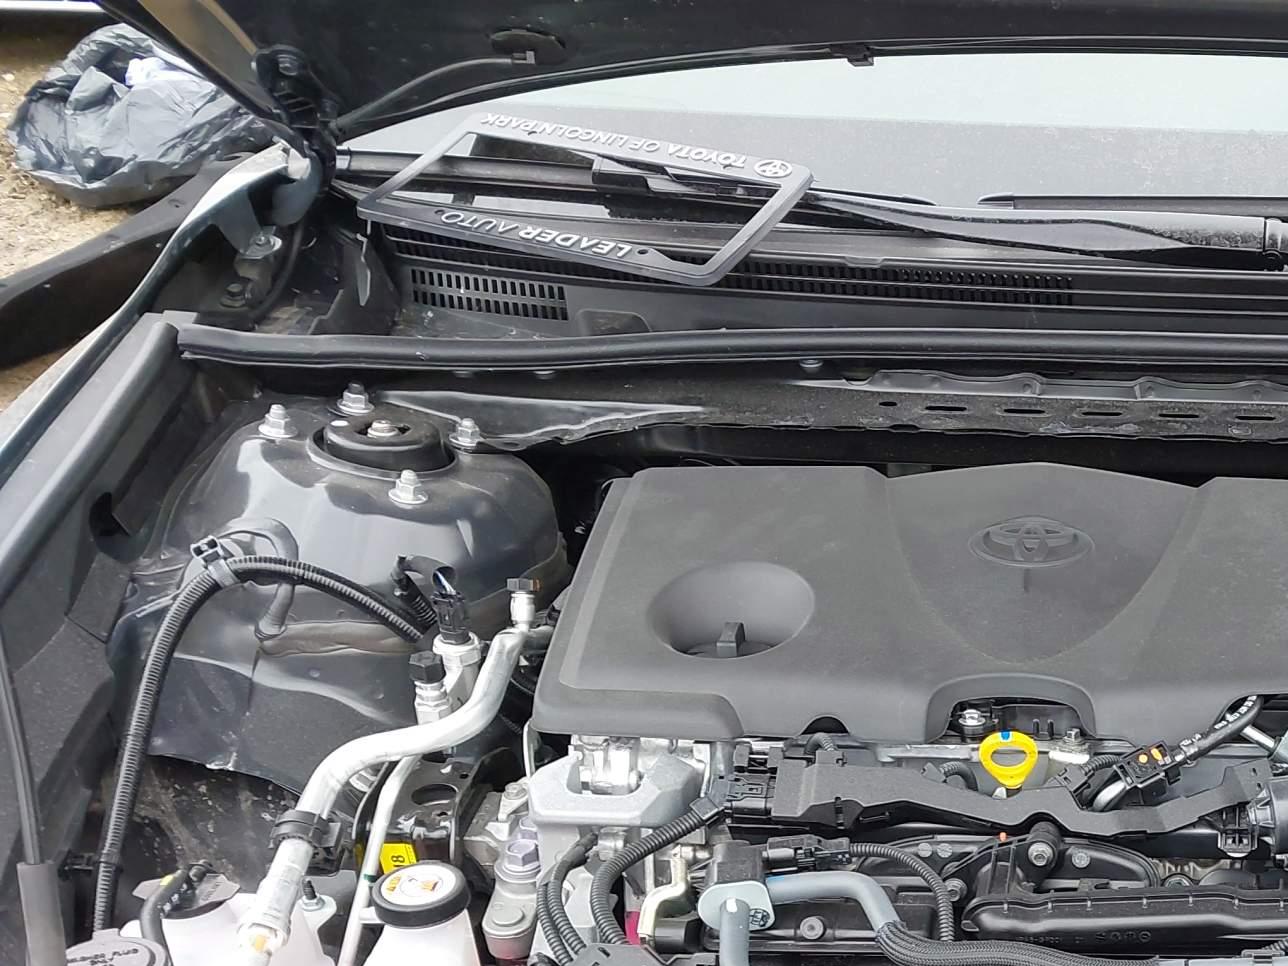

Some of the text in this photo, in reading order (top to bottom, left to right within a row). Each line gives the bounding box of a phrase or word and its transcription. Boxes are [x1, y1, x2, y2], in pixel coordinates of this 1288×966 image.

[480, 112, 750, 169] TOYOTA OF LINCOLN PARK
[440, 210, 633, 258] LEADER AUTO
